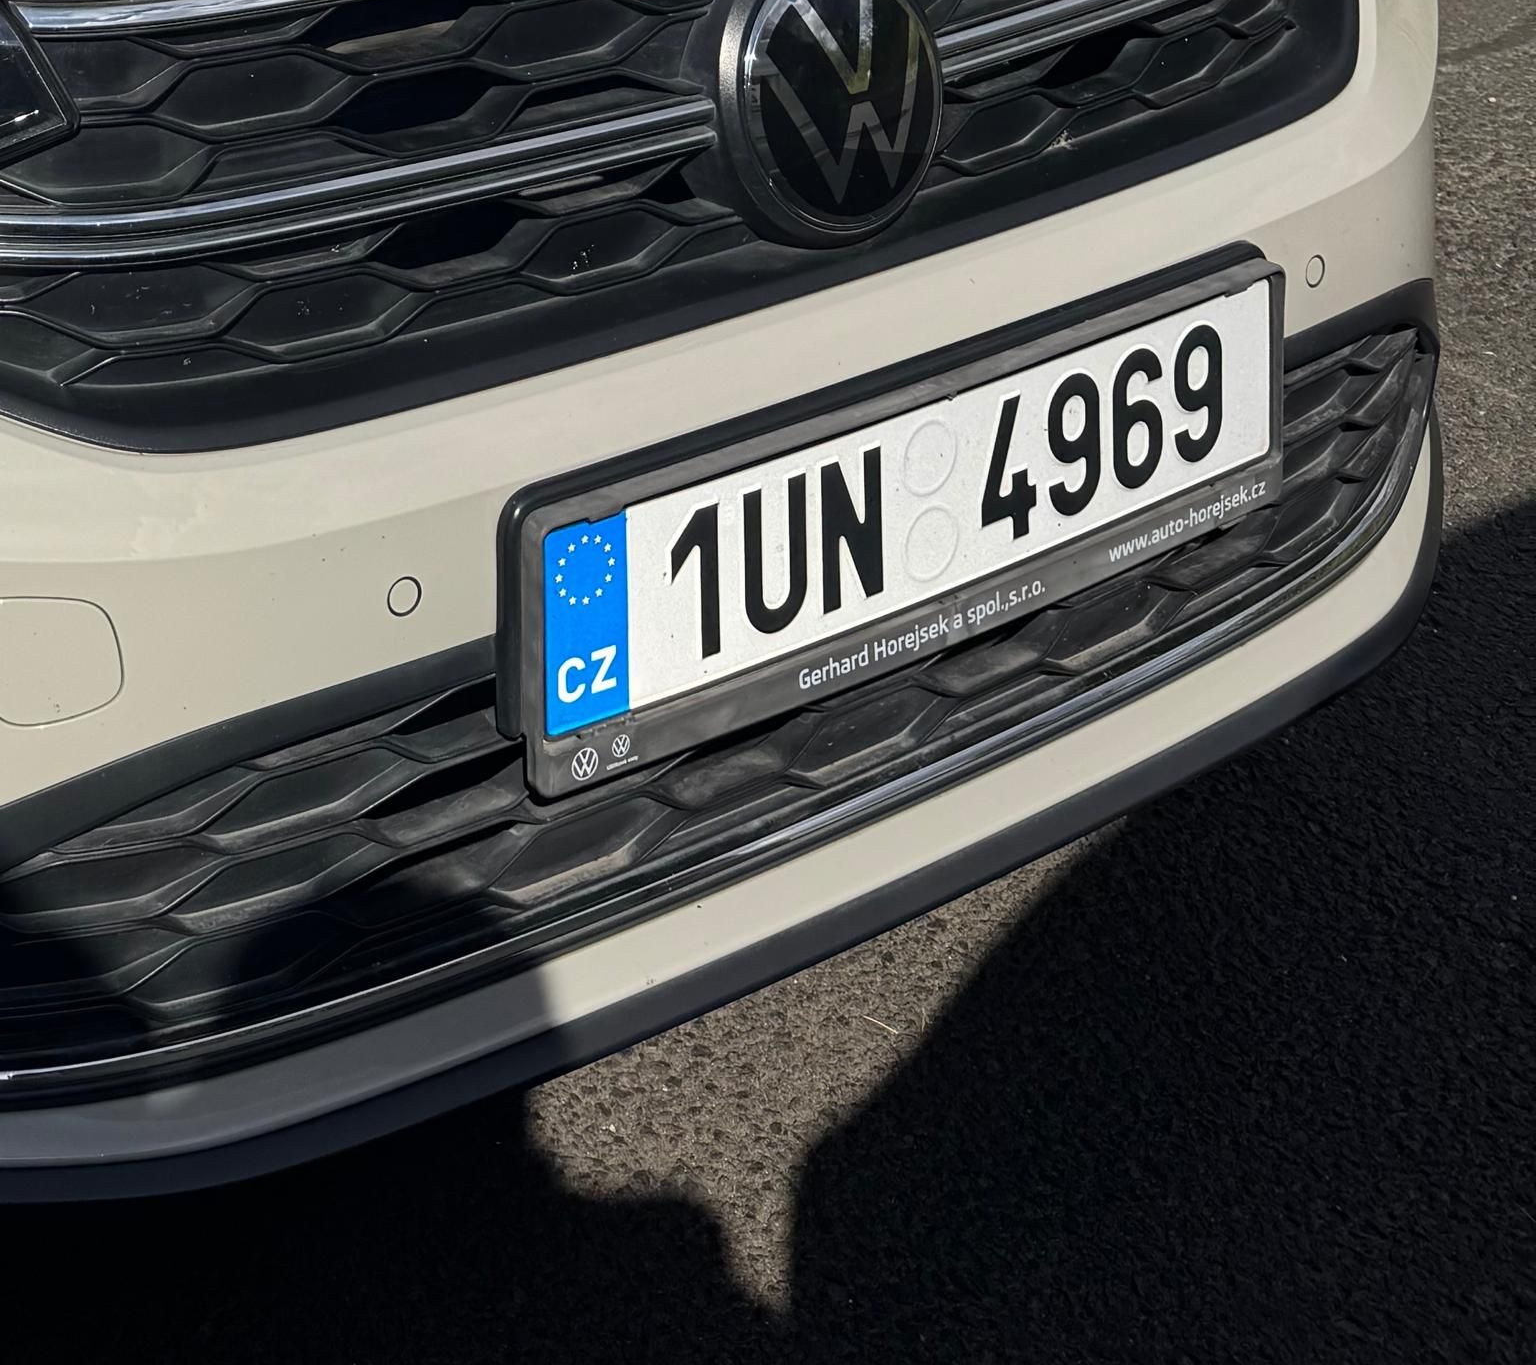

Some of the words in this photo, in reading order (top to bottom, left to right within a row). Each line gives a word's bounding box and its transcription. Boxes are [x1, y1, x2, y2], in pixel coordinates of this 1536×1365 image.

[669, 445, 884, 660] 1UN
[981, 323, 1223, 541] 4969
[1108, 480, 1266, 562] www.auto-horejsek.cz
[557, 644, 617, 703] CZ
[798, 644, 869, 690] Gerhard
[874, 614, 950, 662] Horejsek
[953, 615, 964, 630] a
